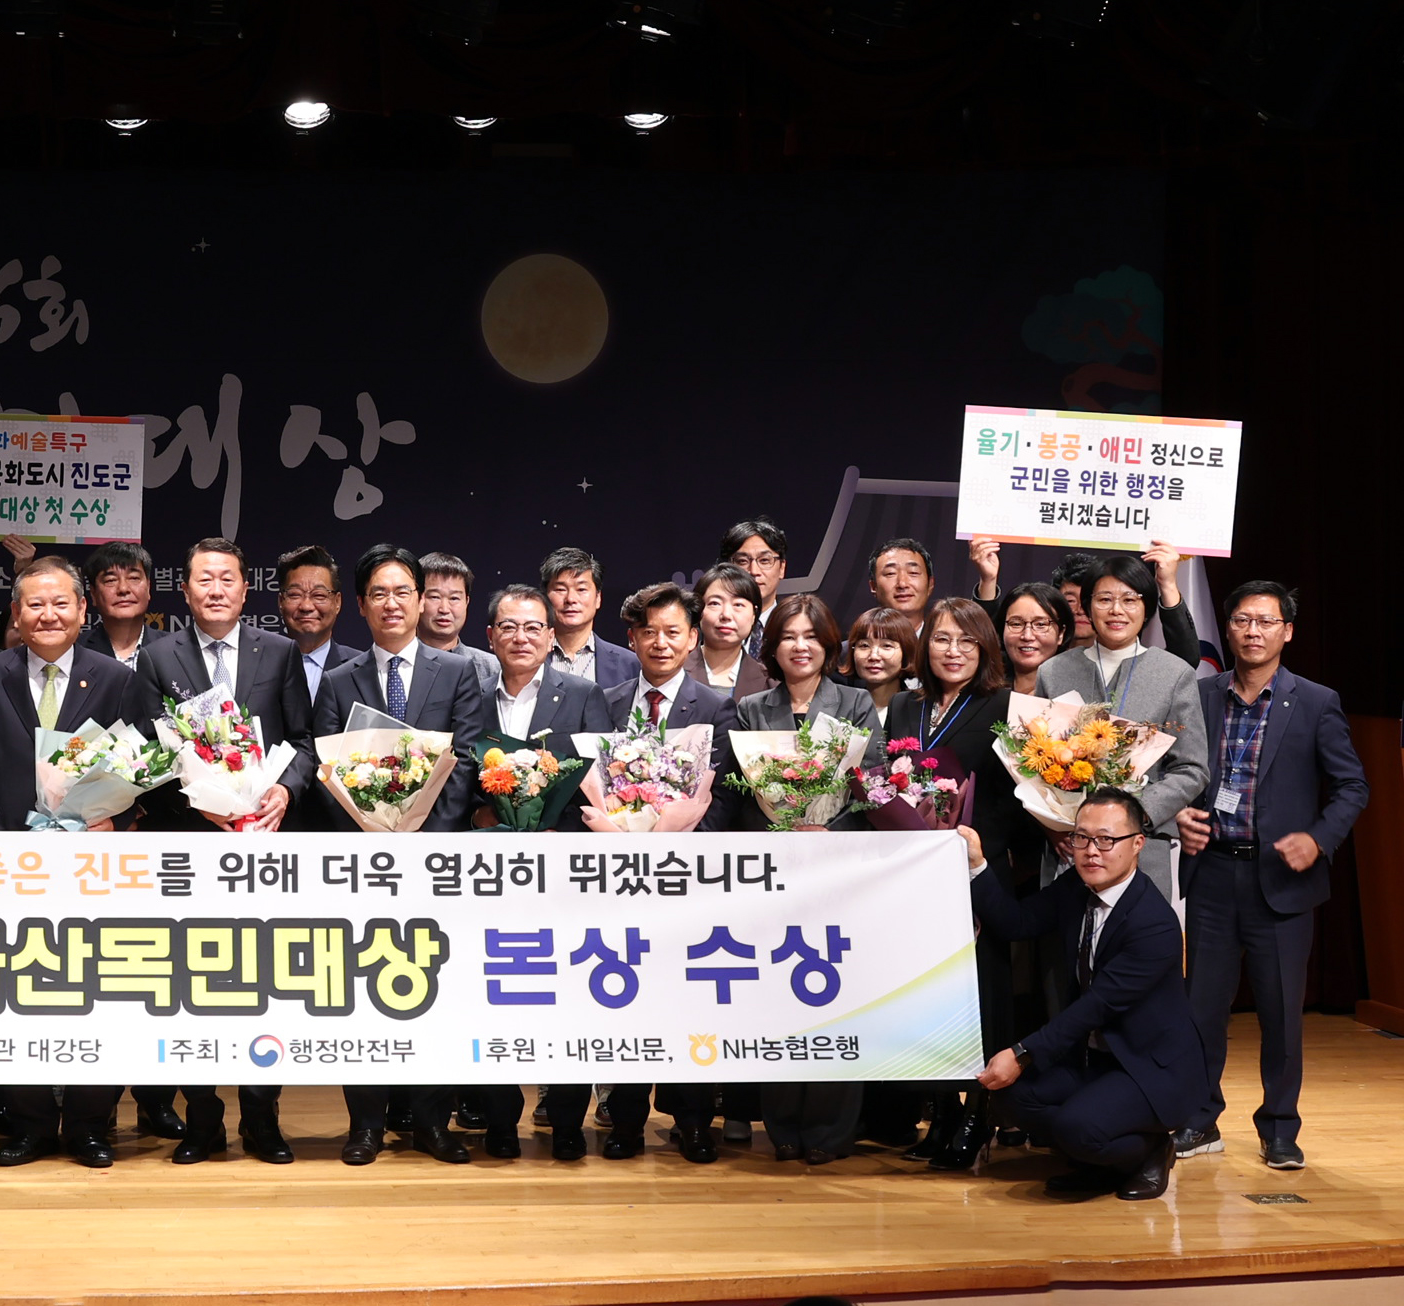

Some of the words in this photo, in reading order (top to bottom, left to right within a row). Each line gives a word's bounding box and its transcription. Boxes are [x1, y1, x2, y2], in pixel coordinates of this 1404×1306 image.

[977, 429, 1019, 457] 율기
[1038, 434, 1081, 460] 봉공
[1100, 437, 1142, 464] 애민
[1151, 443, 1223, 467] 정신으로
[71, 462, 131, 490] 진도군
[1010, 467, 1070, 493] 군민을
[1079, 470, 1118, 496] 위한
[1126, 473, 1184, 500] 행정을
[45, 496, 63, 524] 첫
[70, 498, 110, 526] 수상
[1039, 502, 1150, 530] 펼치겠습니다
[75, 853, 195, 896] 진도를
[217, 852, 298, 893] 위해
[323, 852, 402, 896] 더욱
[425, 852, 545, 896] 열심히
[569, 851, 785, 896] 뛰겠습니다.
[484, 927, 650, 1009] 본상
[686, 925, 851, 1007] 수상
[29, 1039, 102, 1063] 대강당
[170, 1040, 218, 1062] 주최
[290, 1039, 415, 1063] 행정안전부
[486, 1038, 535, 1062] 후원
[566, 1038, 673, 1062] 내일신문,
[723, 1036, 859, 1061] NH농협은행
